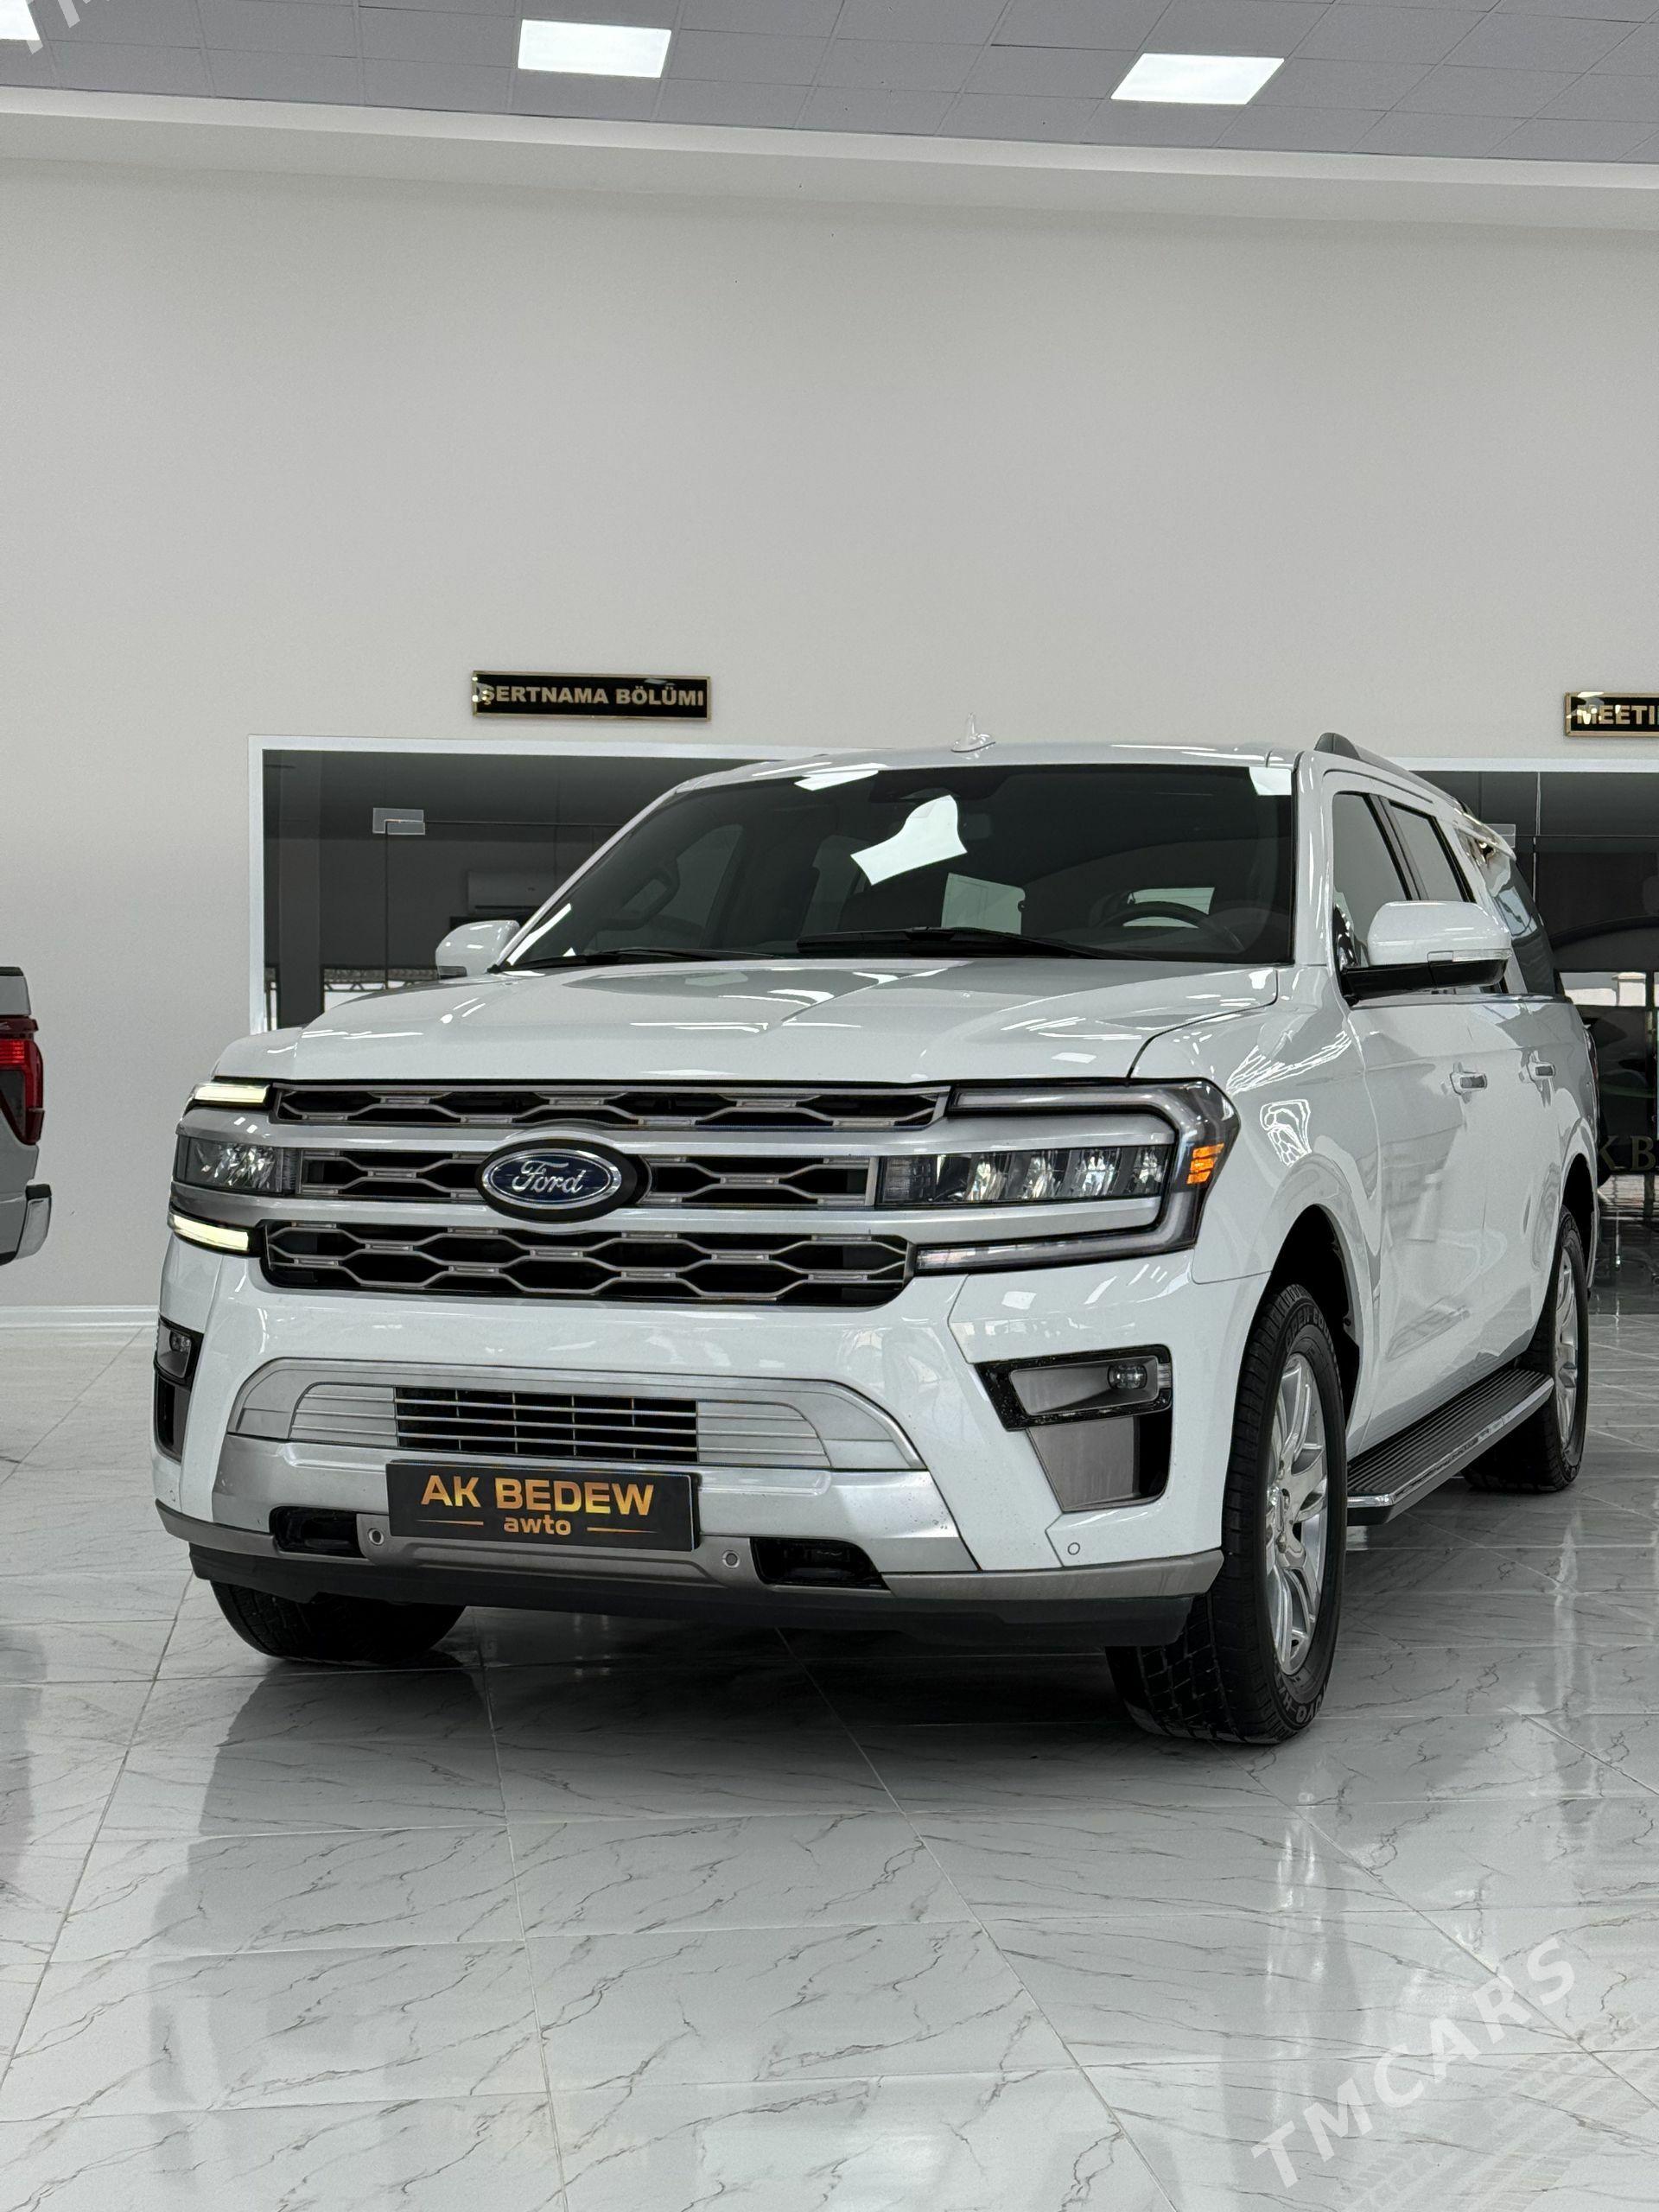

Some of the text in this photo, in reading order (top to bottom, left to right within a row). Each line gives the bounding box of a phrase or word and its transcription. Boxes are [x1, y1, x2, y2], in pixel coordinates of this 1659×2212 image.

[1576, 704, 1659, 725] MEETI
[512, 1160, 587, 1193] Ford
[421, 1474, 654, 1516] AK BEDEW
[504, 1514, 571, 1536] awto
